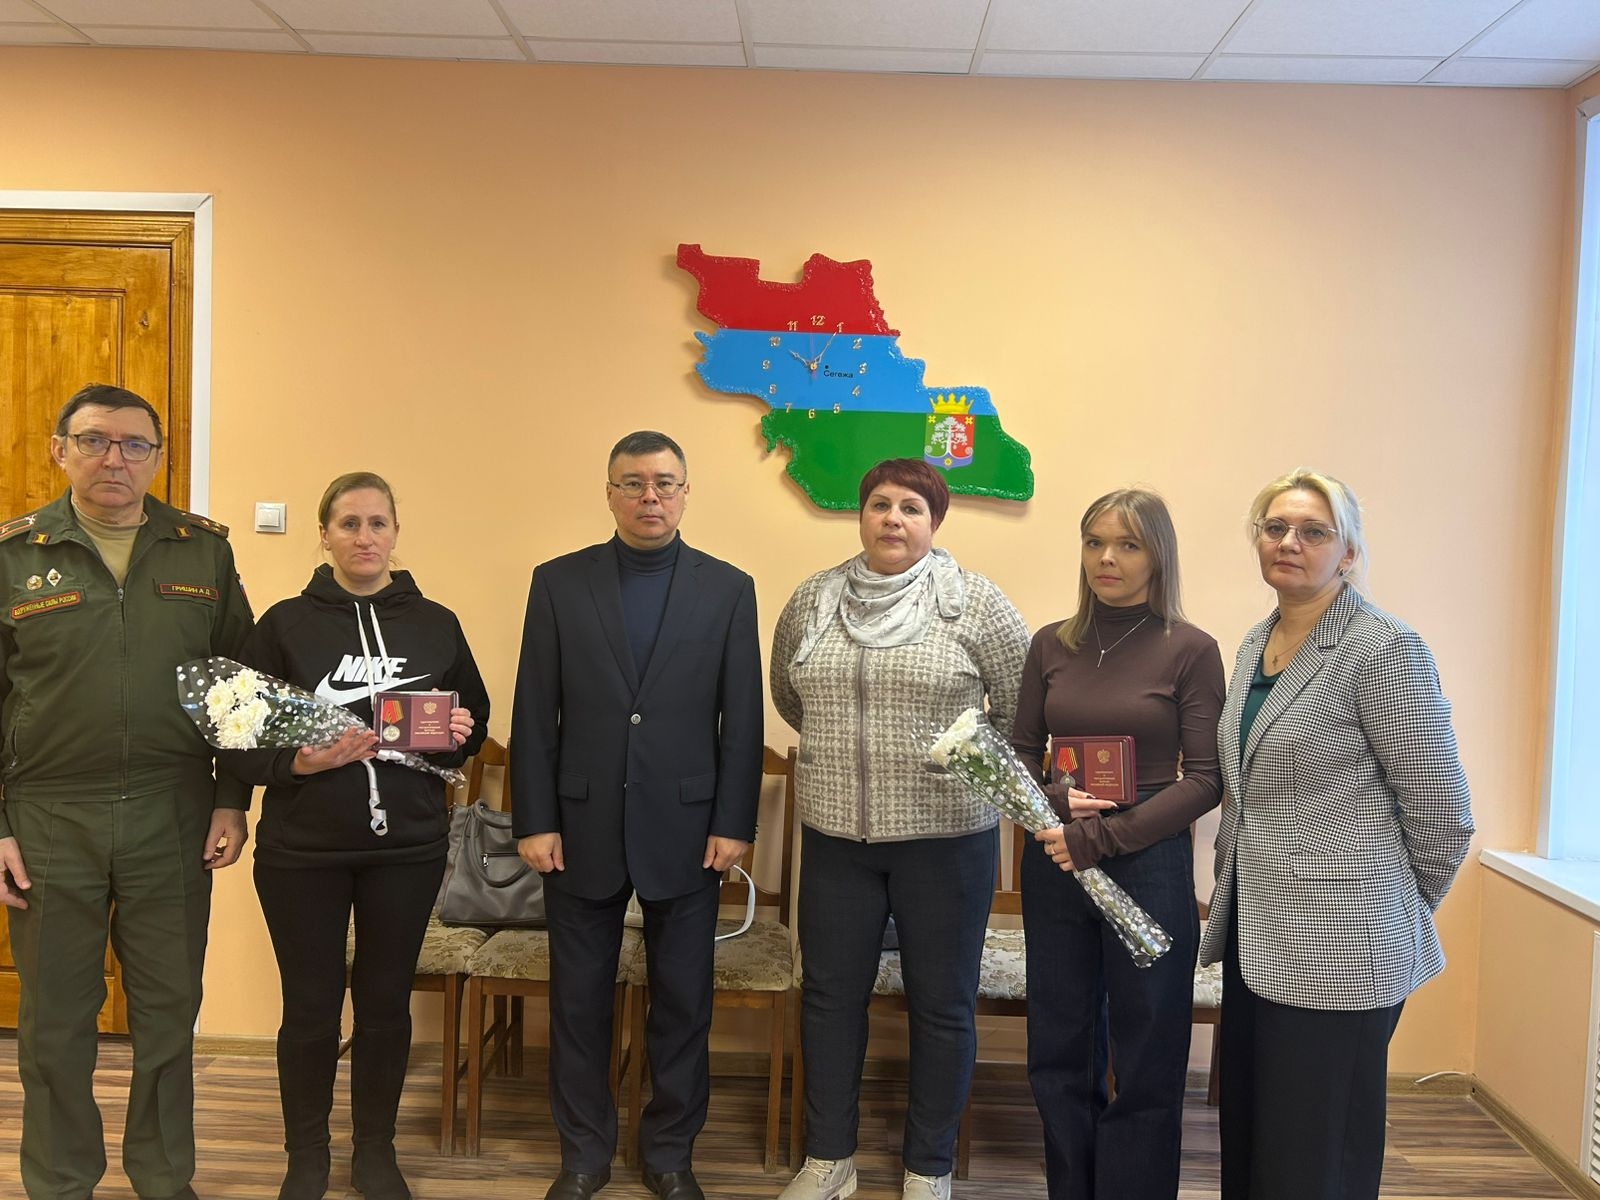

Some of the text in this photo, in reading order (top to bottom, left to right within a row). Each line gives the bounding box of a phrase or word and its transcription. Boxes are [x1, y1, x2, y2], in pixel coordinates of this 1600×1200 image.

[787, 320, 799, 331] 11
[810, 315, 826, 326] 12
[836, 322, 844, 333] 1
[852, 338, 862, 349] 2
[860, 362, 868, 374] 3
[823, 370, 854, 378] Сегежа
[852, 385, 860, 396] 4
[784, 402, 792, 413] 7
[808, 408, 816, 418] 6
[833, 403, 840, 414] 5
[172, 586, 198, 594] ГРИШИН
[332, 654, 408, 684] NIKE
